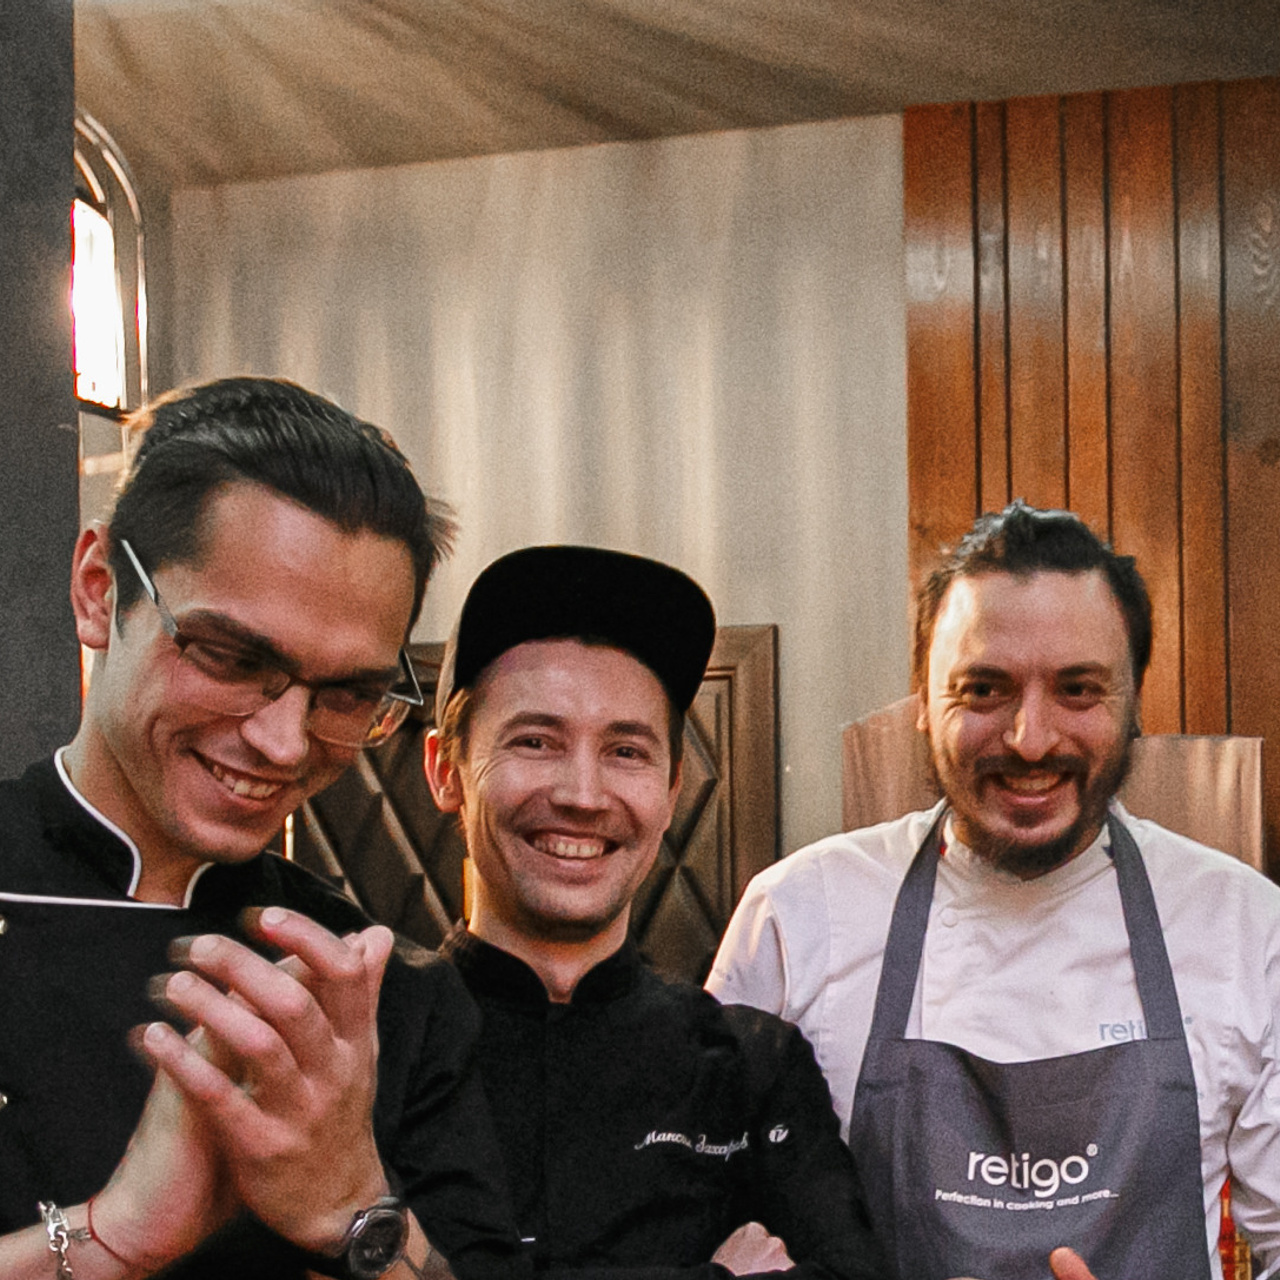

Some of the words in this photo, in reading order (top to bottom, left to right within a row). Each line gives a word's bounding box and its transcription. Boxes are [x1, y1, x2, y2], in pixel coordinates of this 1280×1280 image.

[1099, 1020, 1146, 1040] reti
[935, 1189, 991, 1208] Perfection
[992, 1195, 1004, 1209] in
[1006, 1199, 1055, 1211] cooking
[1056, 1194, 1079, 1206] and
